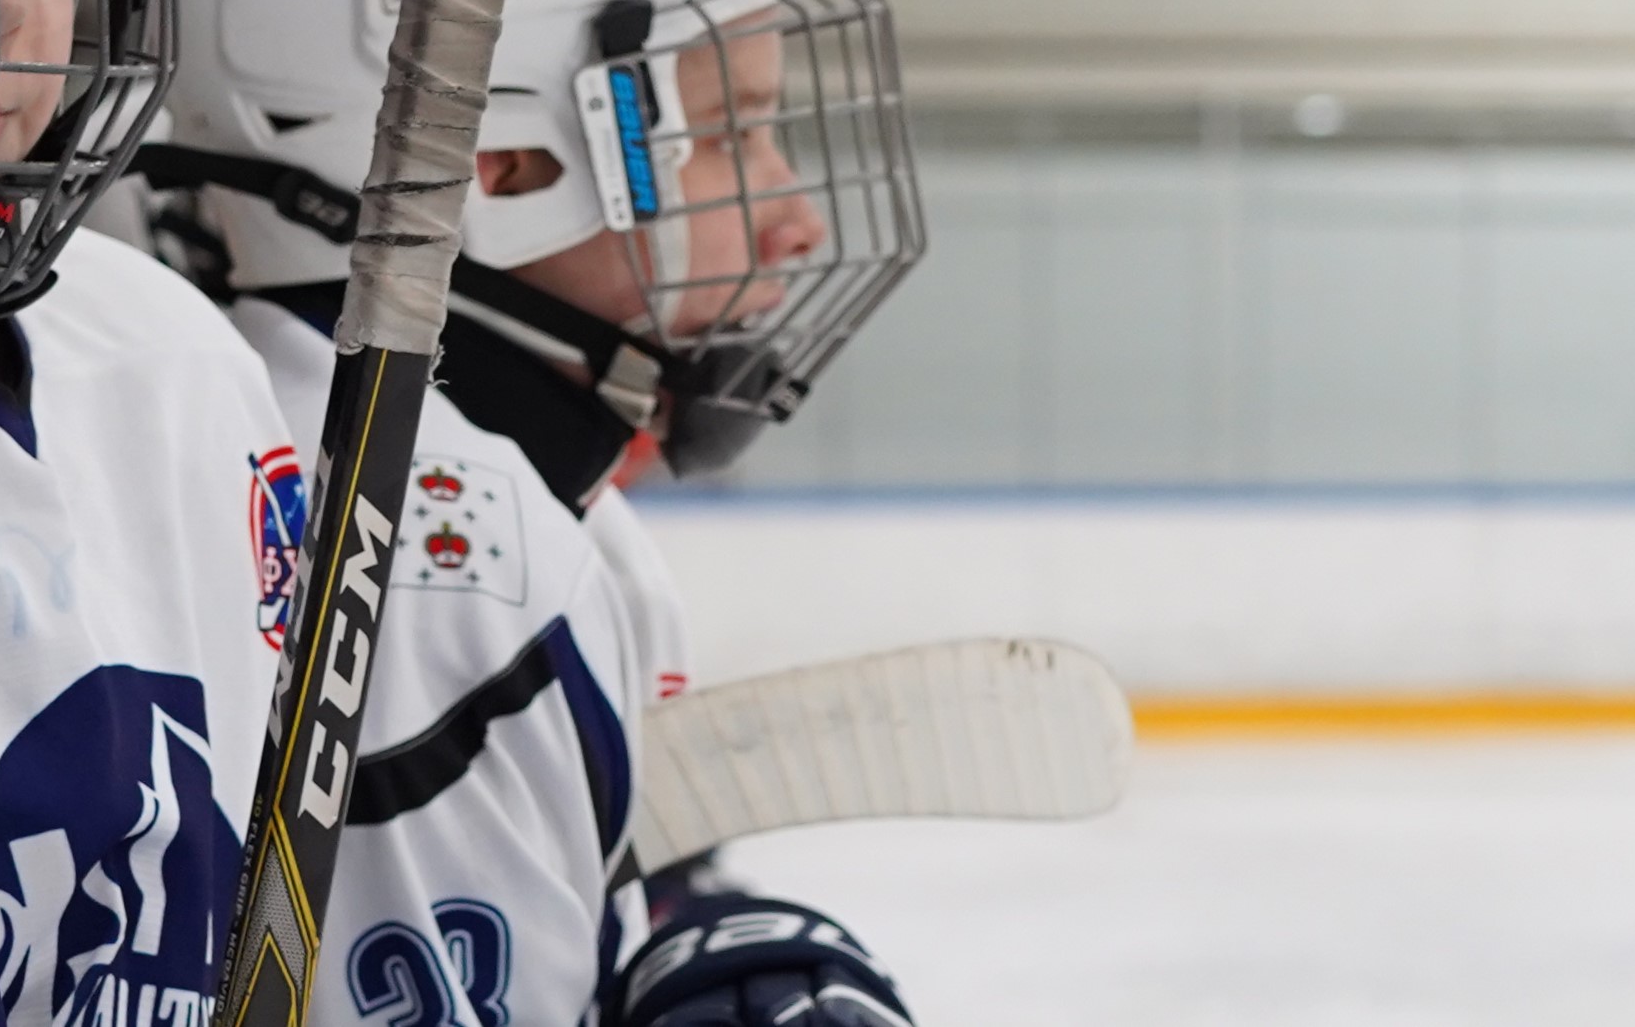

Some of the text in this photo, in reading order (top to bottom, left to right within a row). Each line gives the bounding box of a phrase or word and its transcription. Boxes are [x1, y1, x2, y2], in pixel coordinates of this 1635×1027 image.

[297, 492, 394, 830] CCM
[243, 822, 261, 868] FLEX
[235, 872, 250, 916] GRIP
[216, 932, 238, 1013] MCDAVID
